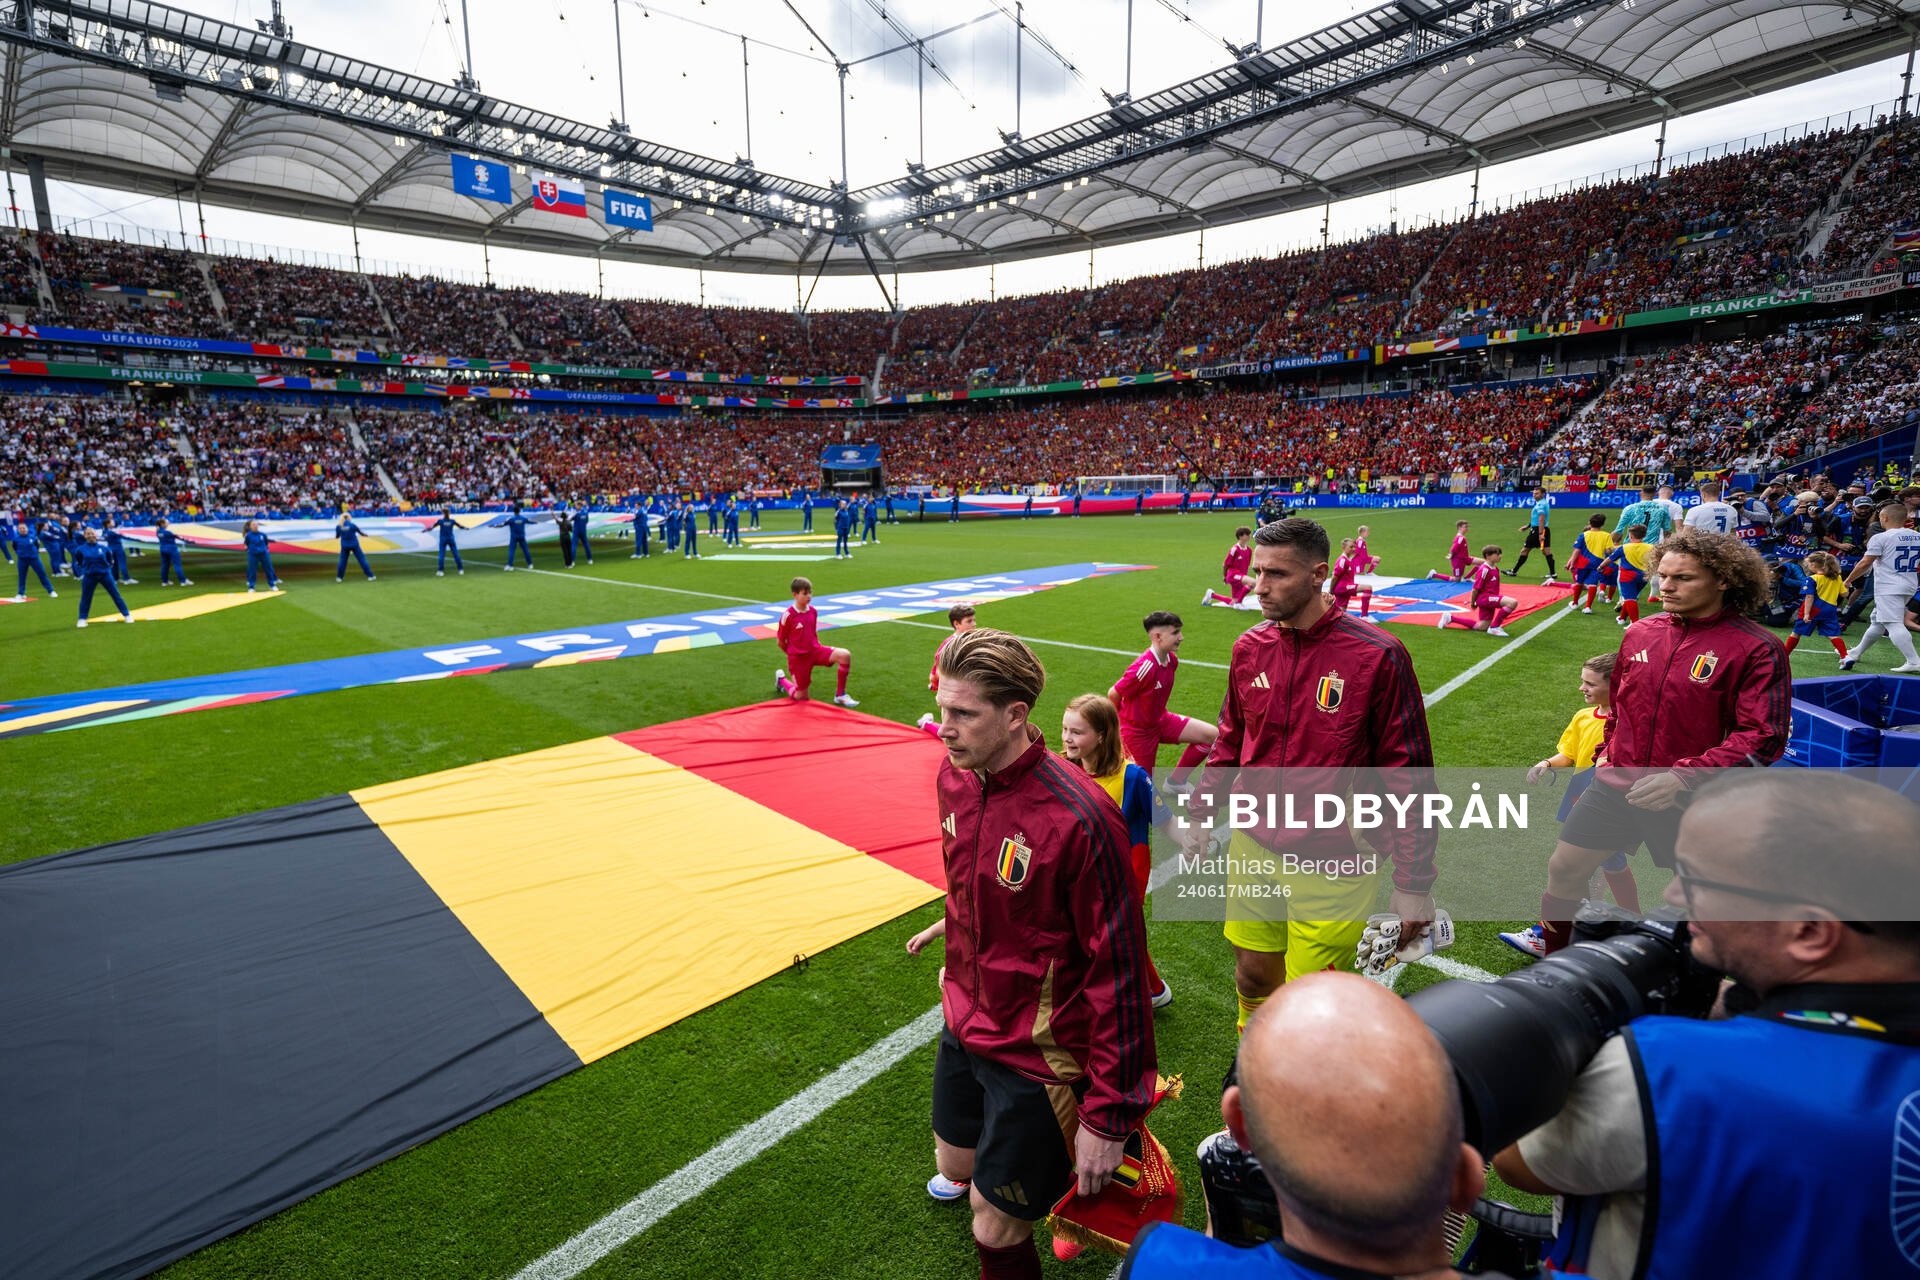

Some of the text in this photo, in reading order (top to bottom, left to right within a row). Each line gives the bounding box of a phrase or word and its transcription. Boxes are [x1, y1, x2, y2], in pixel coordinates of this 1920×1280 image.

[610, 201, 647, 221] FIFA
[1690, 291, 1812, 317] FRANKFUT
[111, 368, 203, 382] FRANKFURT
[566, 366, 620, 376] FRANKFURT
[1440, 477, 1478, 488] NAMUR
[1618, 473, 1656, 487] KDB
[1894, 545, 1920, 572] 22
